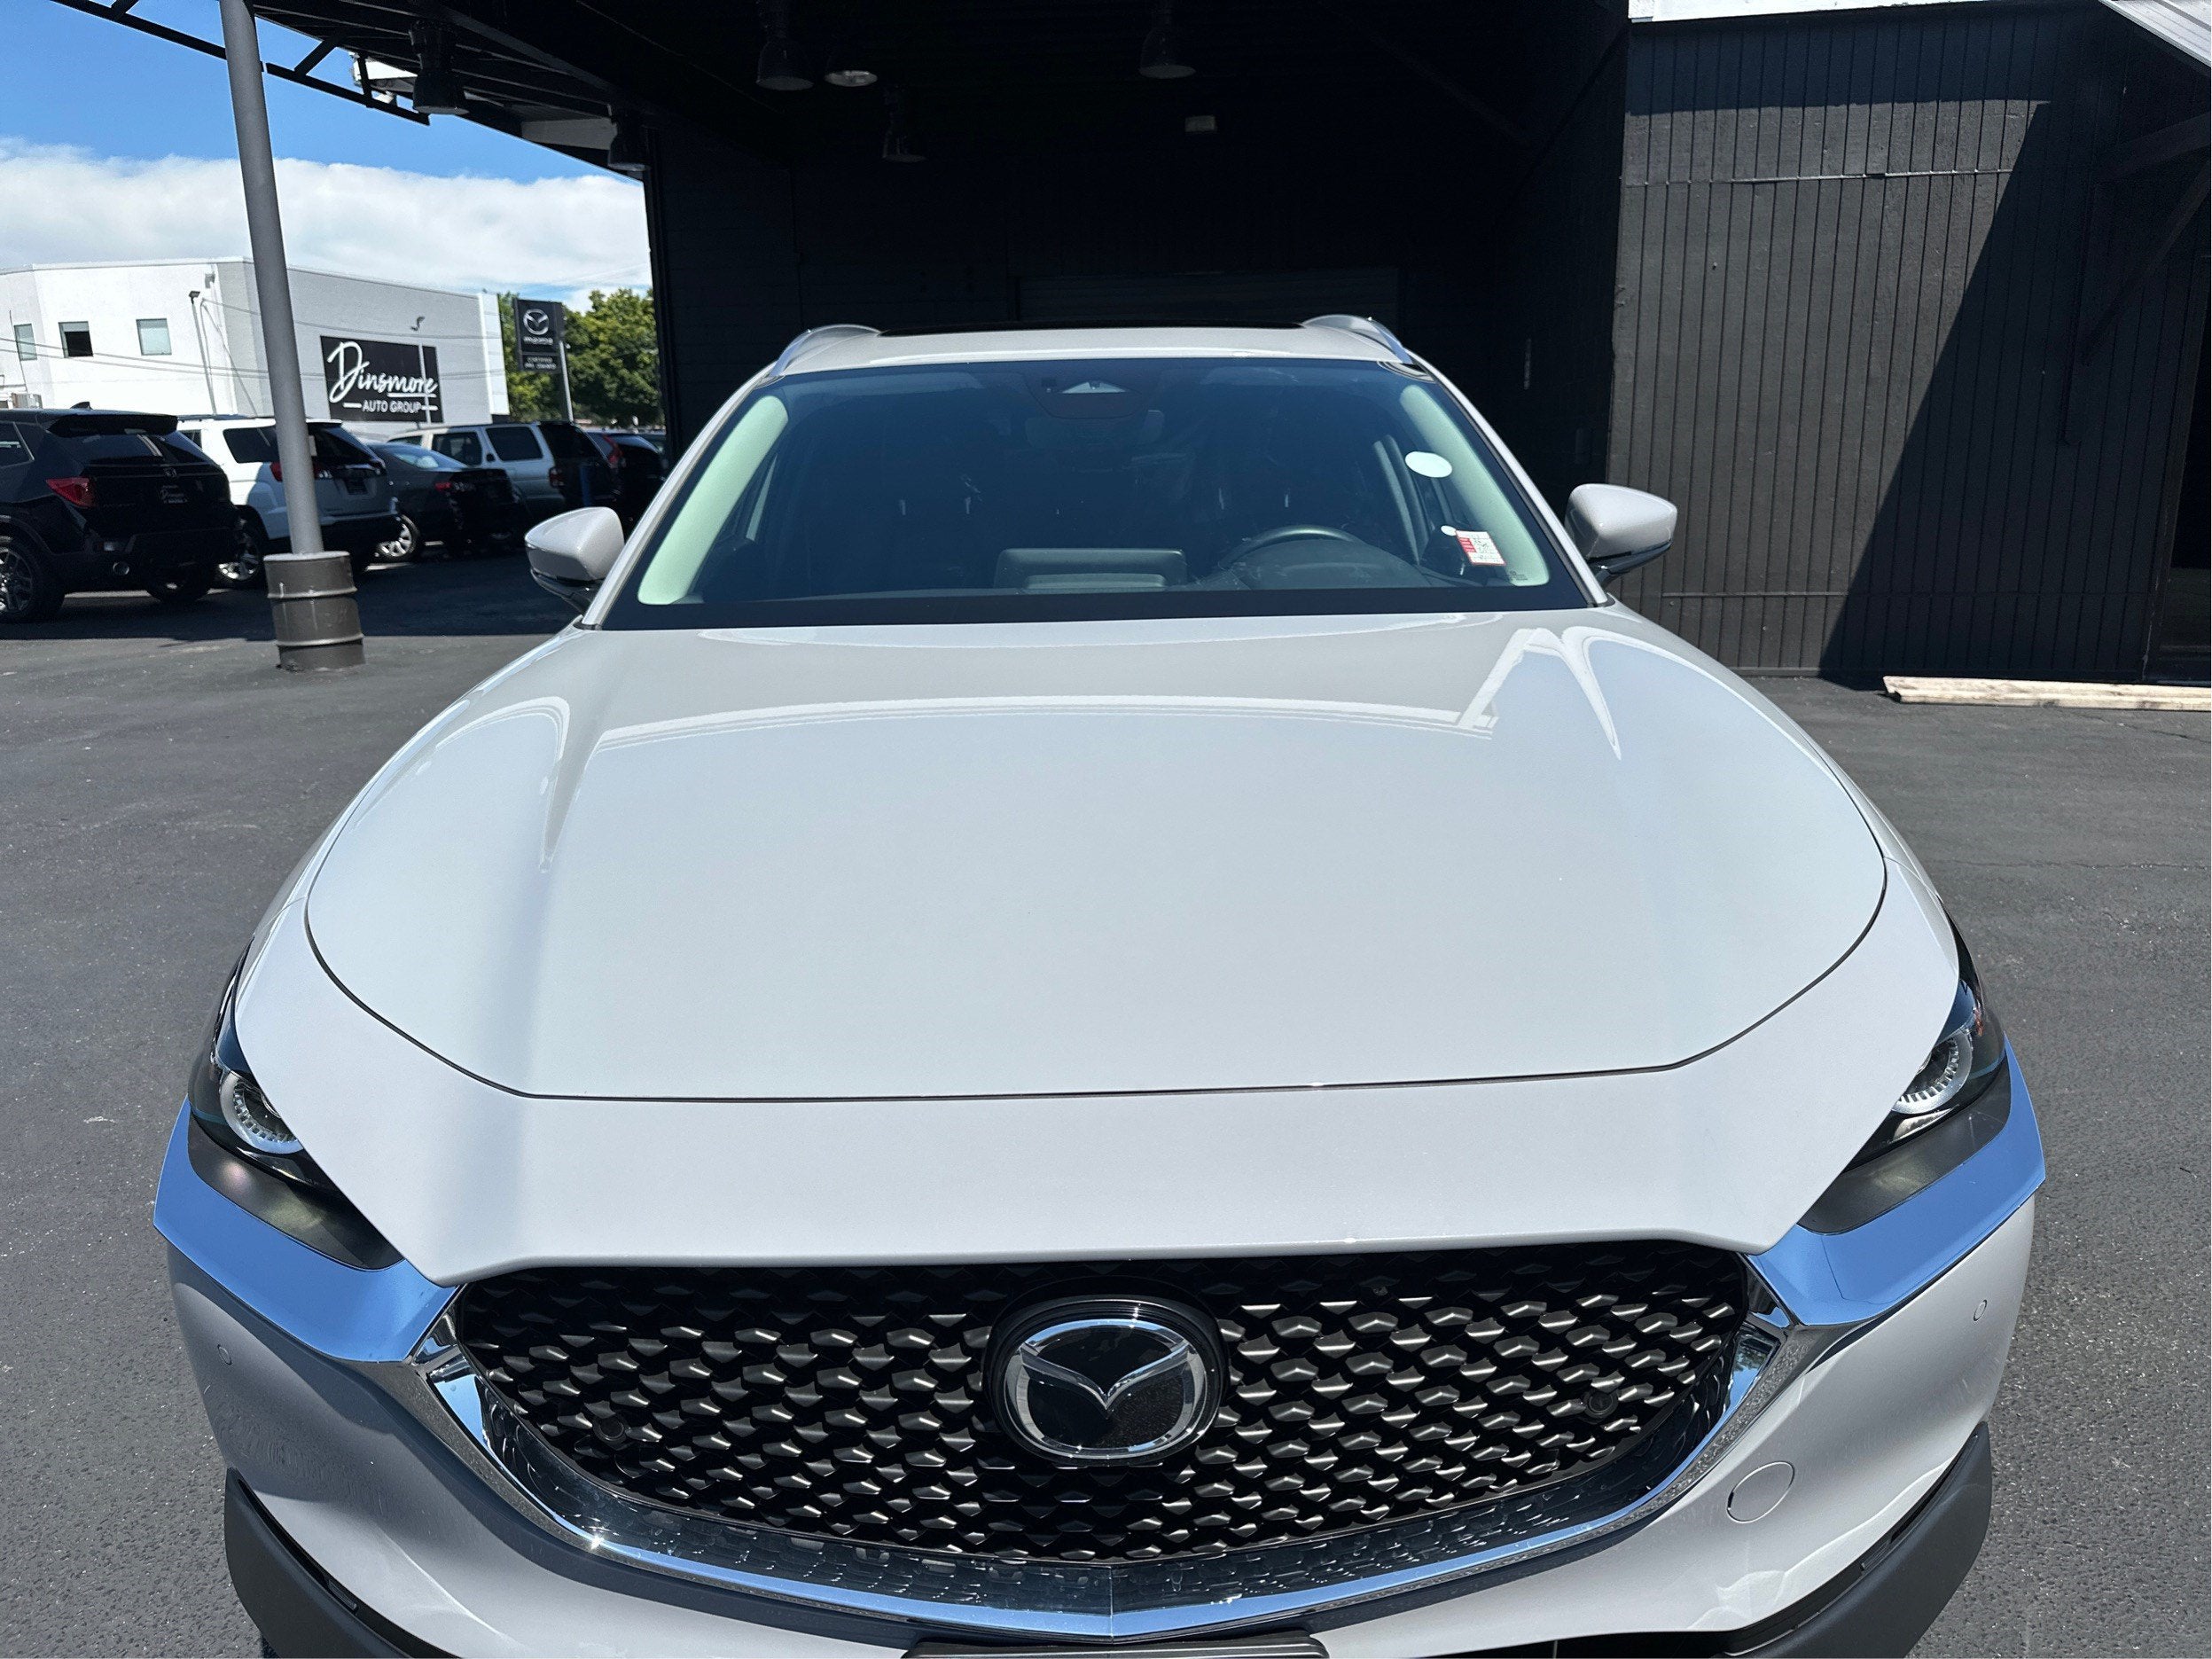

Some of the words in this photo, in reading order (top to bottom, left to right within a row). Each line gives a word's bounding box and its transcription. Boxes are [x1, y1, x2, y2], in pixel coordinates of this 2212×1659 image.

[327, 340, 438, 403] Dinsmore
[362, 400, 388, 413] AUTO
[389, 402, 421, 414] GROUP
